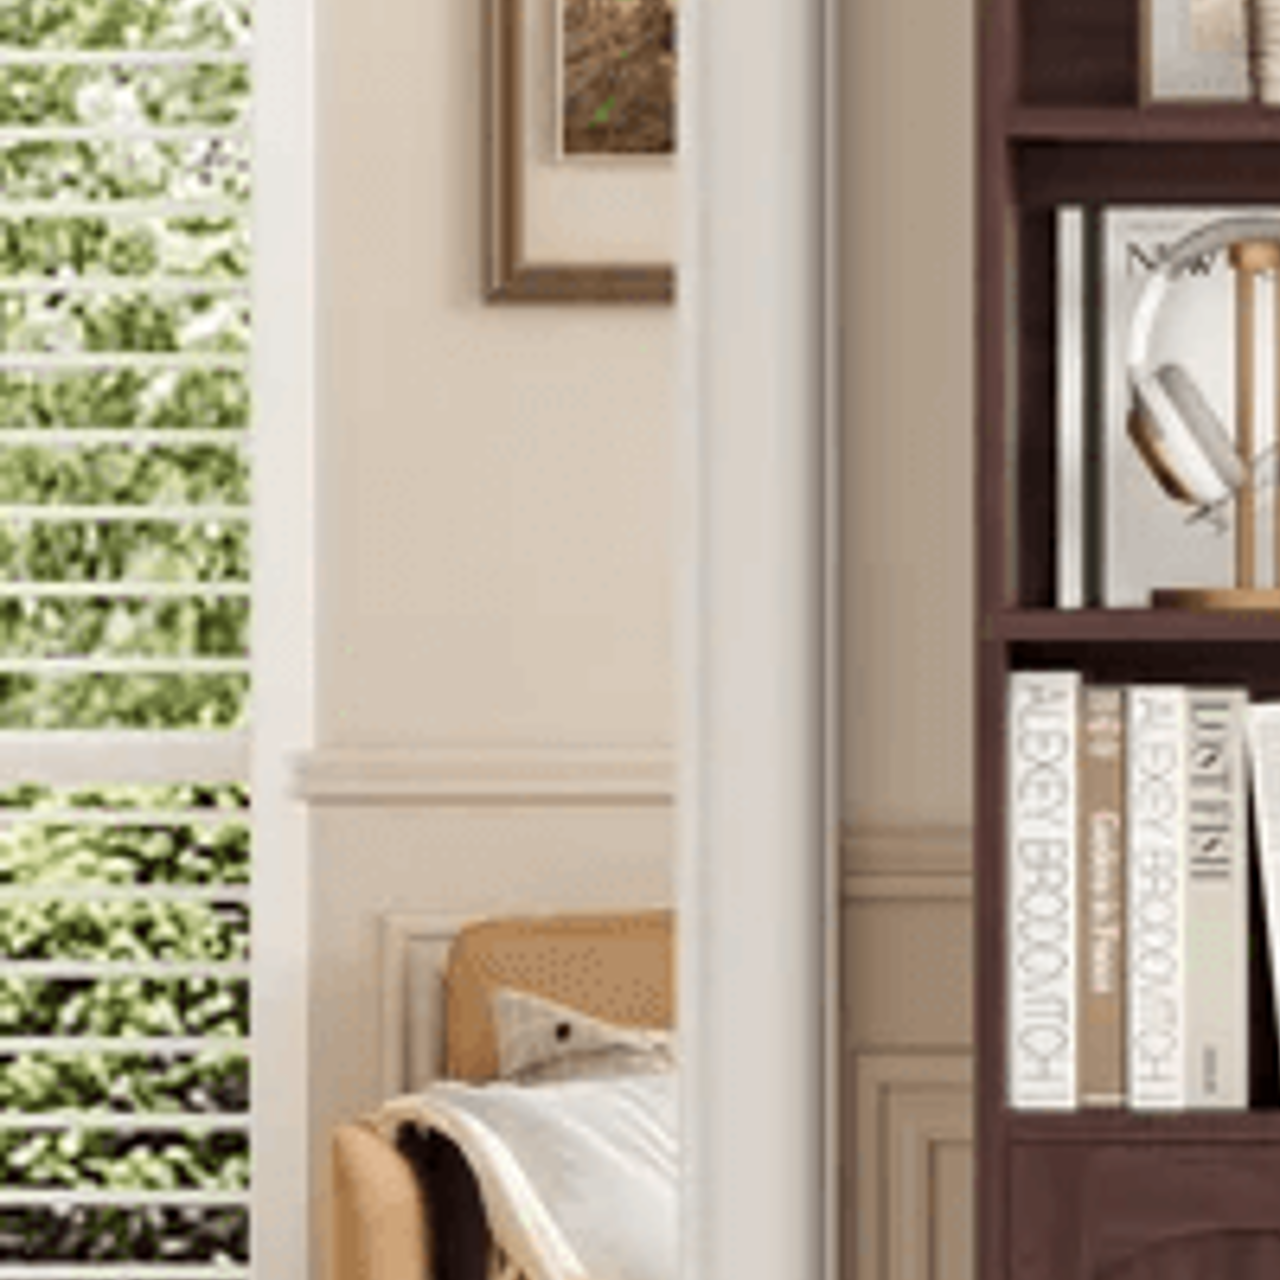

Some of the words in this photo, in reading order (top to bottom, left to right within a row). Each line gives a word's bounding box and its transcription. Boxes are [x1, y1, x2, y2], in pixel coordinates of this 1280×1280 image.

[1017, 683, 1070, 827] ALEXEY
[1137, 696, 1179, 836] ALEXEY
[1189, 700, 1231, 788] LOST
[1189, 799, 1231, 879] FISH
[1017, 838, 1070, 1084] BRODOVITCH
